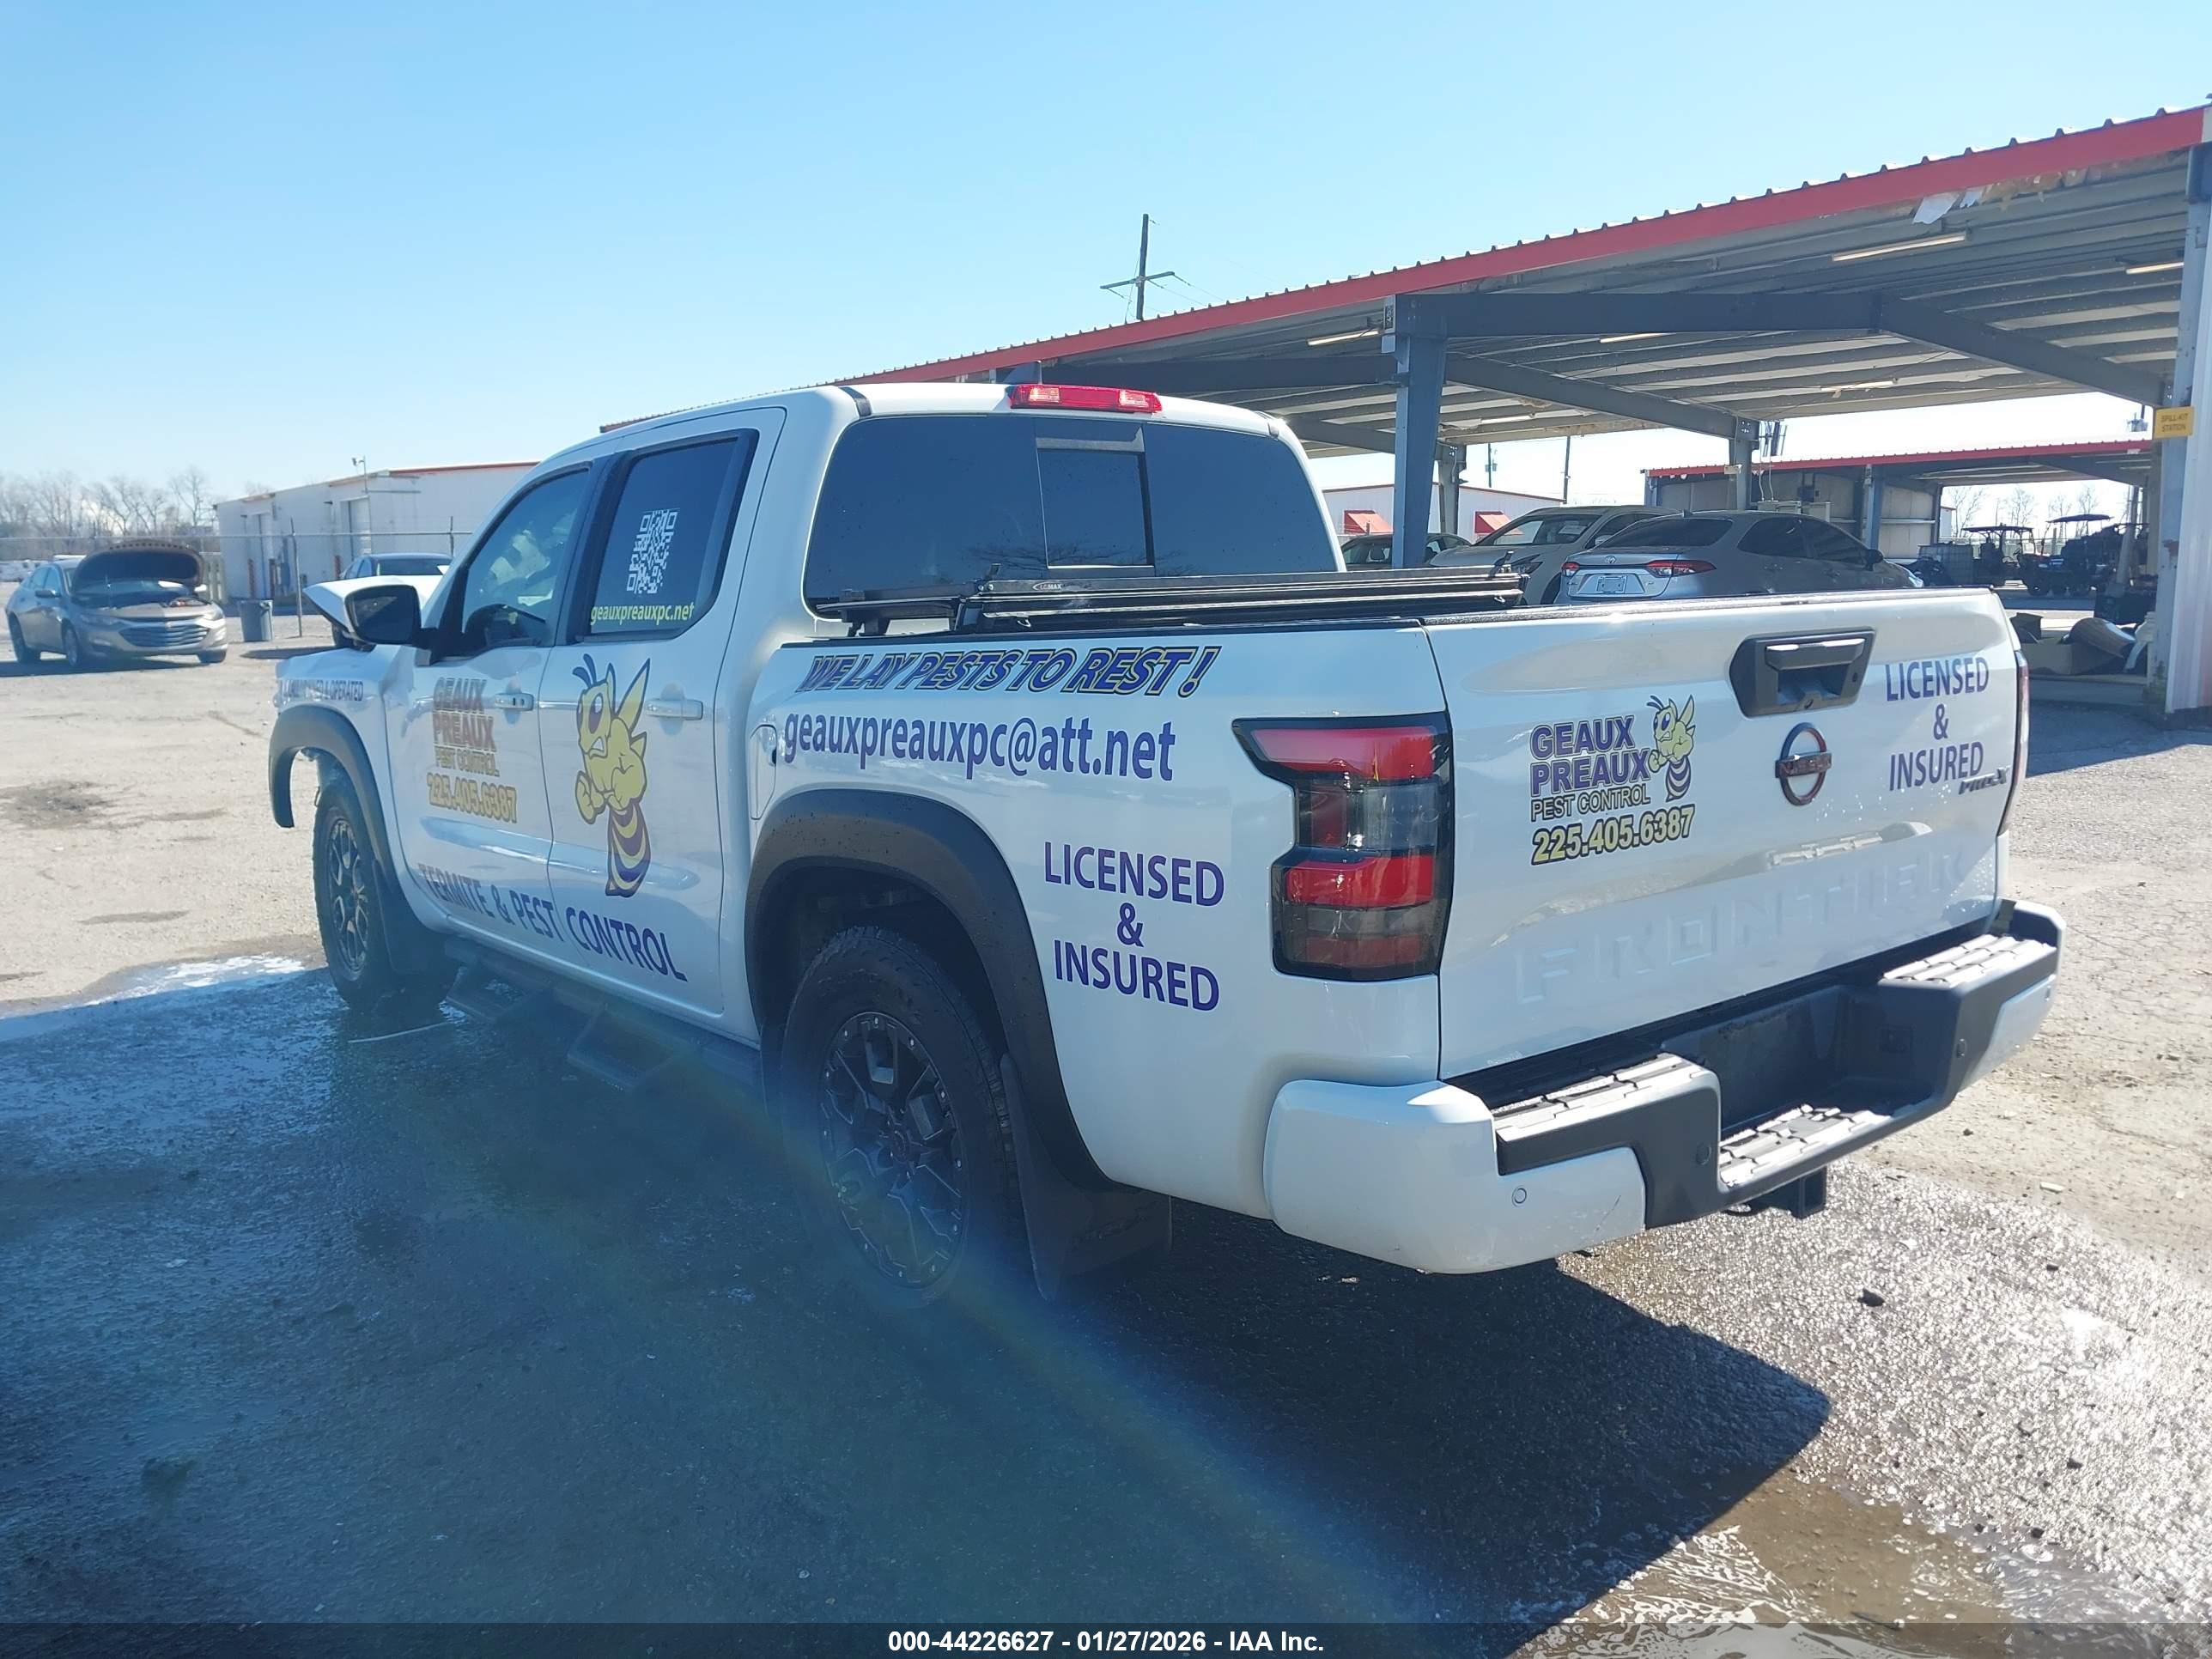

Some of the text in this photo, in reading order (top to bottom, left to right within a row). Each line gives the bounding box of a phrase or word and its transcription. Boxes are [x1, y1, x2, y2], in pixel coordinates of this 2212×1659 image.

[590, 602, 695, 626] geauxpreauxpc.net
[795, 653, 860, 692] WE
[836, 653, 921, 690] LAY
[894, 647, 1024, 691] PESTS
[1006, 647, 1078, 693] TO
[1884, 656, 1990, 702] LICENSED
[434, 677, 487, 714] GEAUX
[433, 712, 497, 752] PREAUX
[1530, 714, 1635, 761] GEAUX
[1933, 703, 1949, 741] &
[434, 746, 501, 777] PEST CONTROL
[784, 711, 1176, 781] geauxpreauxpc@att.net
[1889, 741, 1984, 792] INSURED
[1530, 748, 1651, 797] PREAUX
[427, 772, 518, 823] 225.405.6387
[1531, 783, 1650, 822] PEST CONTROL
[1531, 804, 1696, 866] 225.405.6387
[1043, 841, 1225, 907] LICENSED
[417, 863, 689, 982] TERMITE & PEST CONTROL
[1116, 902, 1145, 947] &
[1054, 939, 1219, 1012] INSURED
